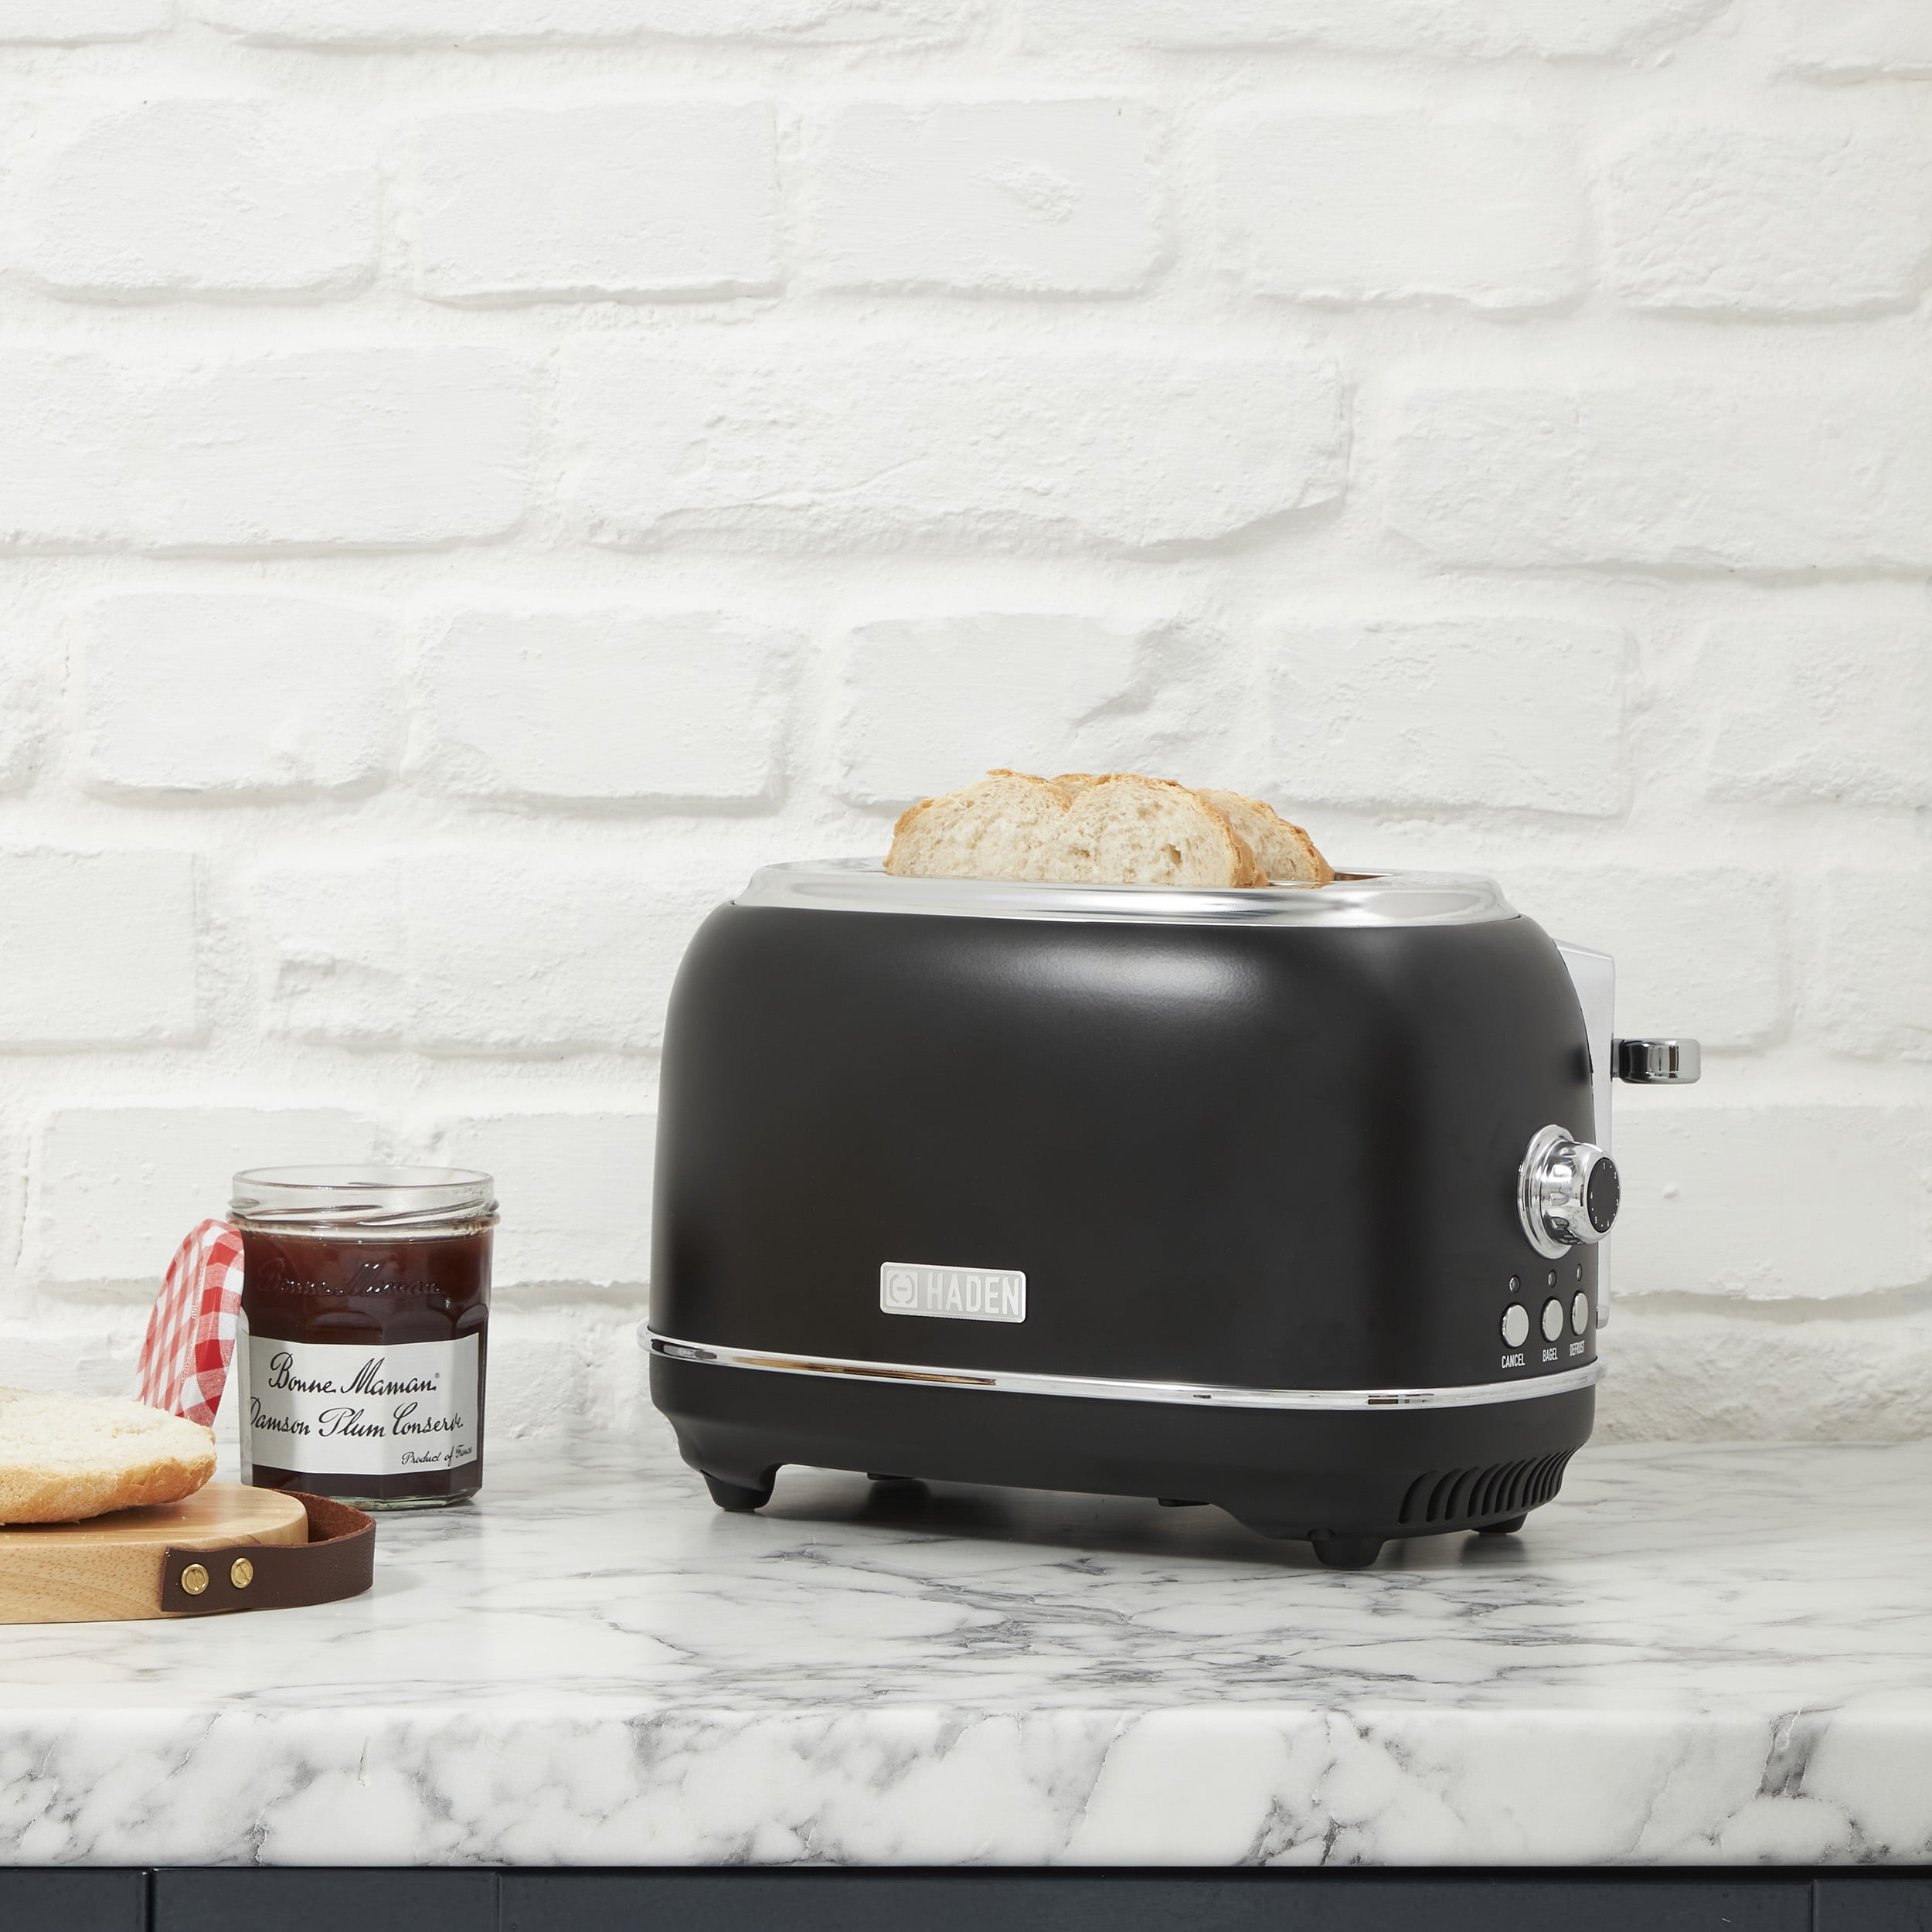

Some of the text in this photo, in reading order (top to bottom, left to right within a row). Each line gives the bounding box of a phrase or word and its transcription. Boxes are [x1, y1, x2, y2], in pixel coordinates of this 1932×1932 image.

[927, 1272, 1020, 1315] HADEN
[1543, 1347, 1558, 1362] BAGEL
[1570, 1340, 1585, 1356] DEFROST
[1502, 1353, 1526, 1369] CANCEL
[268, 1352, 336, 1393] Bonne
[250, 1396, 464, 1437] Damson Plum Conserve
[402, 1451, 441, 1464] Product
[444, 1445, 454, 1467] of
